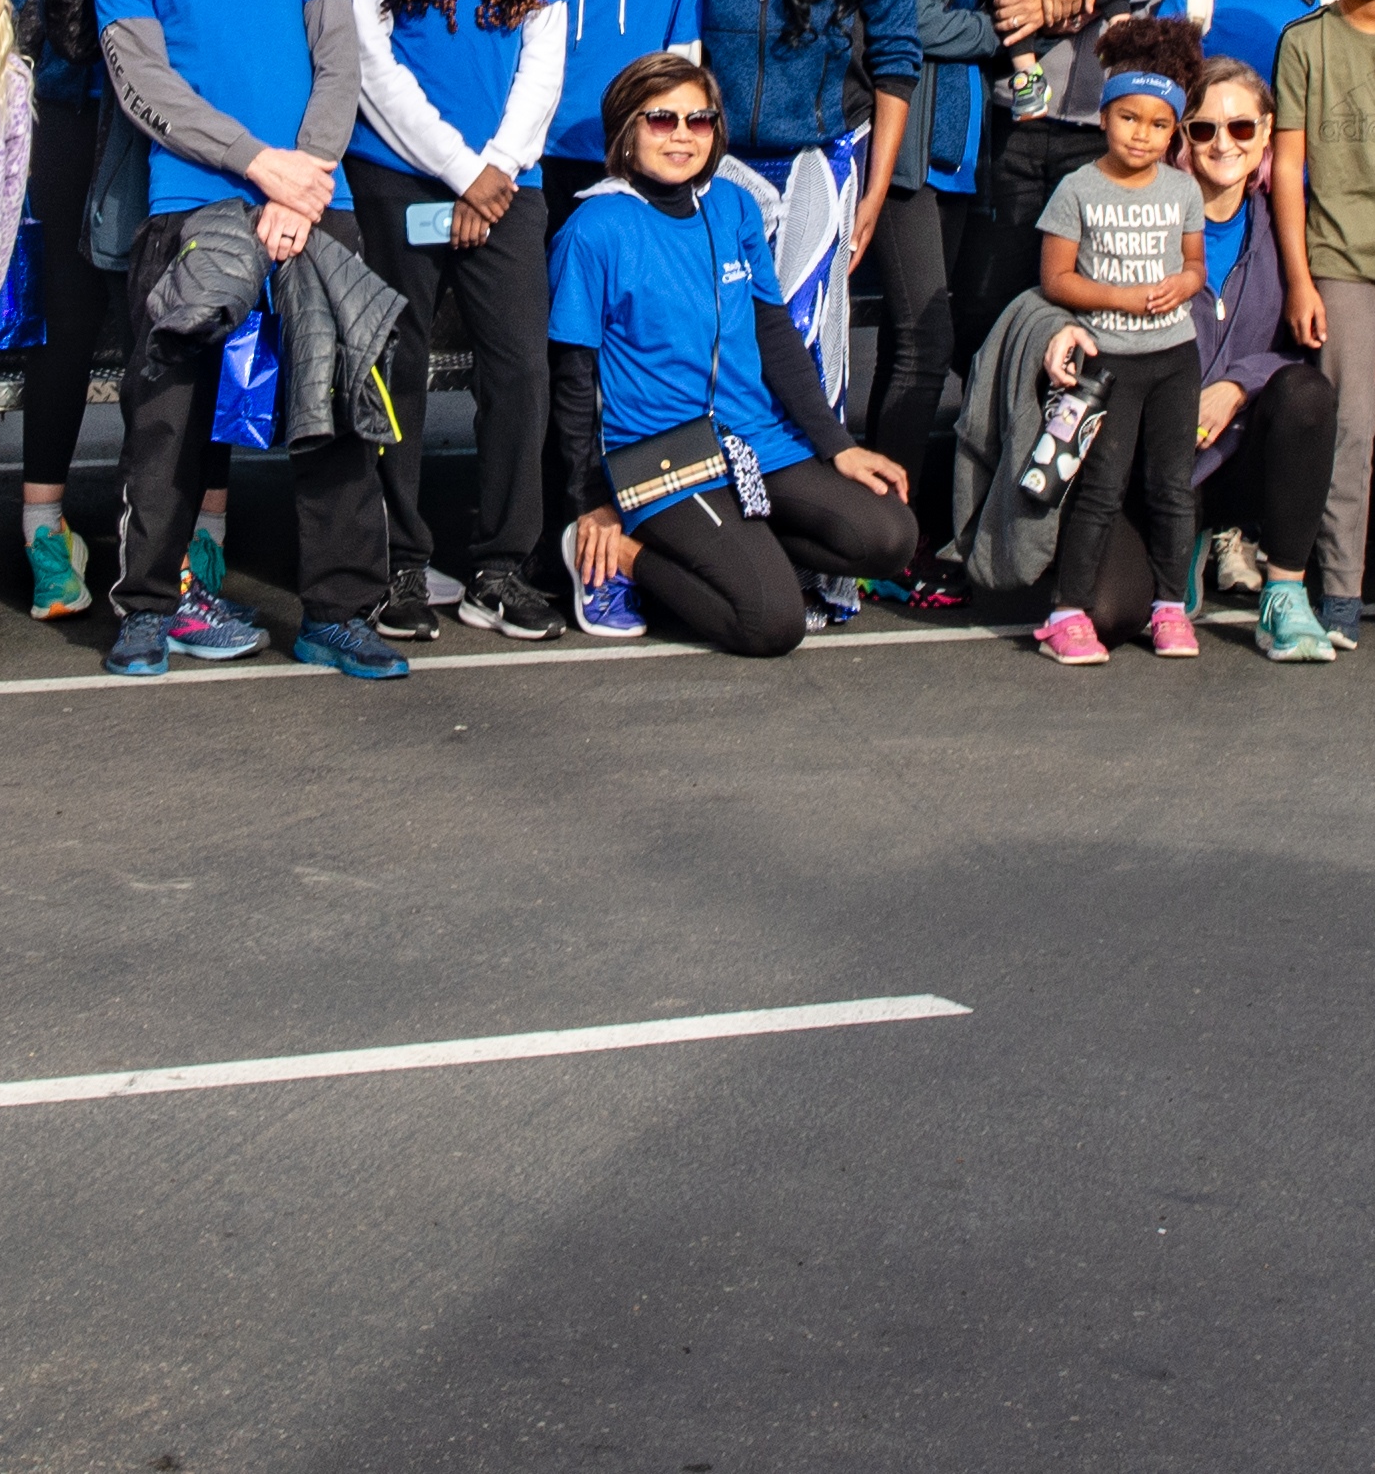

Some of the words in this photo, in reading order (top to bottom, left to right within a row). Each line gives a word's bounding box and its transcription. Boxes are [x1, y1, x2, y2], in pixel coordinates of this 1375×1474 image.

[123, 81, 172, 137] TEAM
[1086, 202, 1180, 228] MALCOLM
[1090, 231, 1169, 256] HARRIET
[1092, 256, 1165, 283] MARTIN
